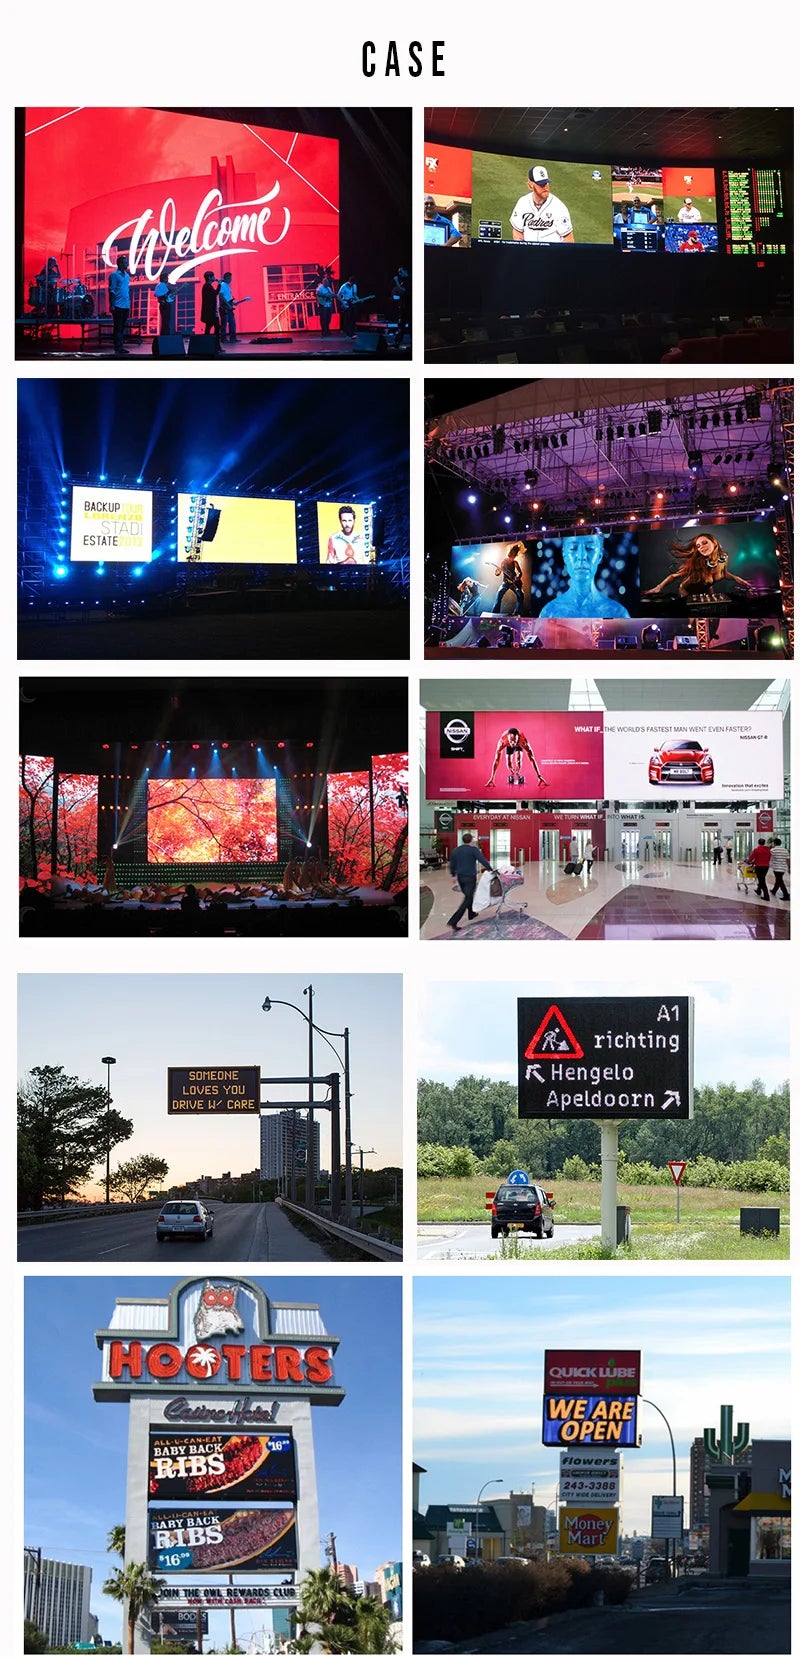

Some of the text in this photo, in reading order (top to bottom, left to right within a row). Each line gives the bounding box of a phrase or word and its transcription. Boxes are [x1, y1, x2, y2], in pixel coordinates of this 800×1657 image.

[522, 212, 554, 230] Padres
[101, 179, 291, 284] Welcome
[84, 501, 120, 512] BACKUP
[101, 521, 143, 535] STADI
[83, 535, 118, 546] ESTATE
[657, 1004, 680, 1022] A1
[594, 1030, 680, 1053] richting
[189, 1071, 239, 1080] SOMEONE
[551, 1063, 634, 1085] Hengelo
[182, 1085, 246, 1095] LOVES YOU
[172, 1100, 255, 1110] DRIVE W/ CARE
[546, 1090, 655, 1111] Apeldoorn
[109, 1340, 333, 1384] HOOTERS
[549, 1366, 636, 1379] QUICK LUBE
[549, 1398, 635, 1420] WE ARE
[561, 1420, 623, 1441] OPEN
[154, 1443, 223, 1457] BABY BACK
[153, 1452, 226, 1479] RIBS
[564, 1481, 616, 1490] 243-3388
[151, 1516, 220, 1530] BABY BACK
[564, 1515, 613, 1535] Money
[152, 1525, 224, 1550] RIBS
[568, 1531, 605, 1545] Mart
[183, 1588, 201, 1598] THE
[204, 1588, 222, 1597] OWL
[227, 1588, 270, 1597] REWARDS
[274, 1587, 296, 1597] CLUB
